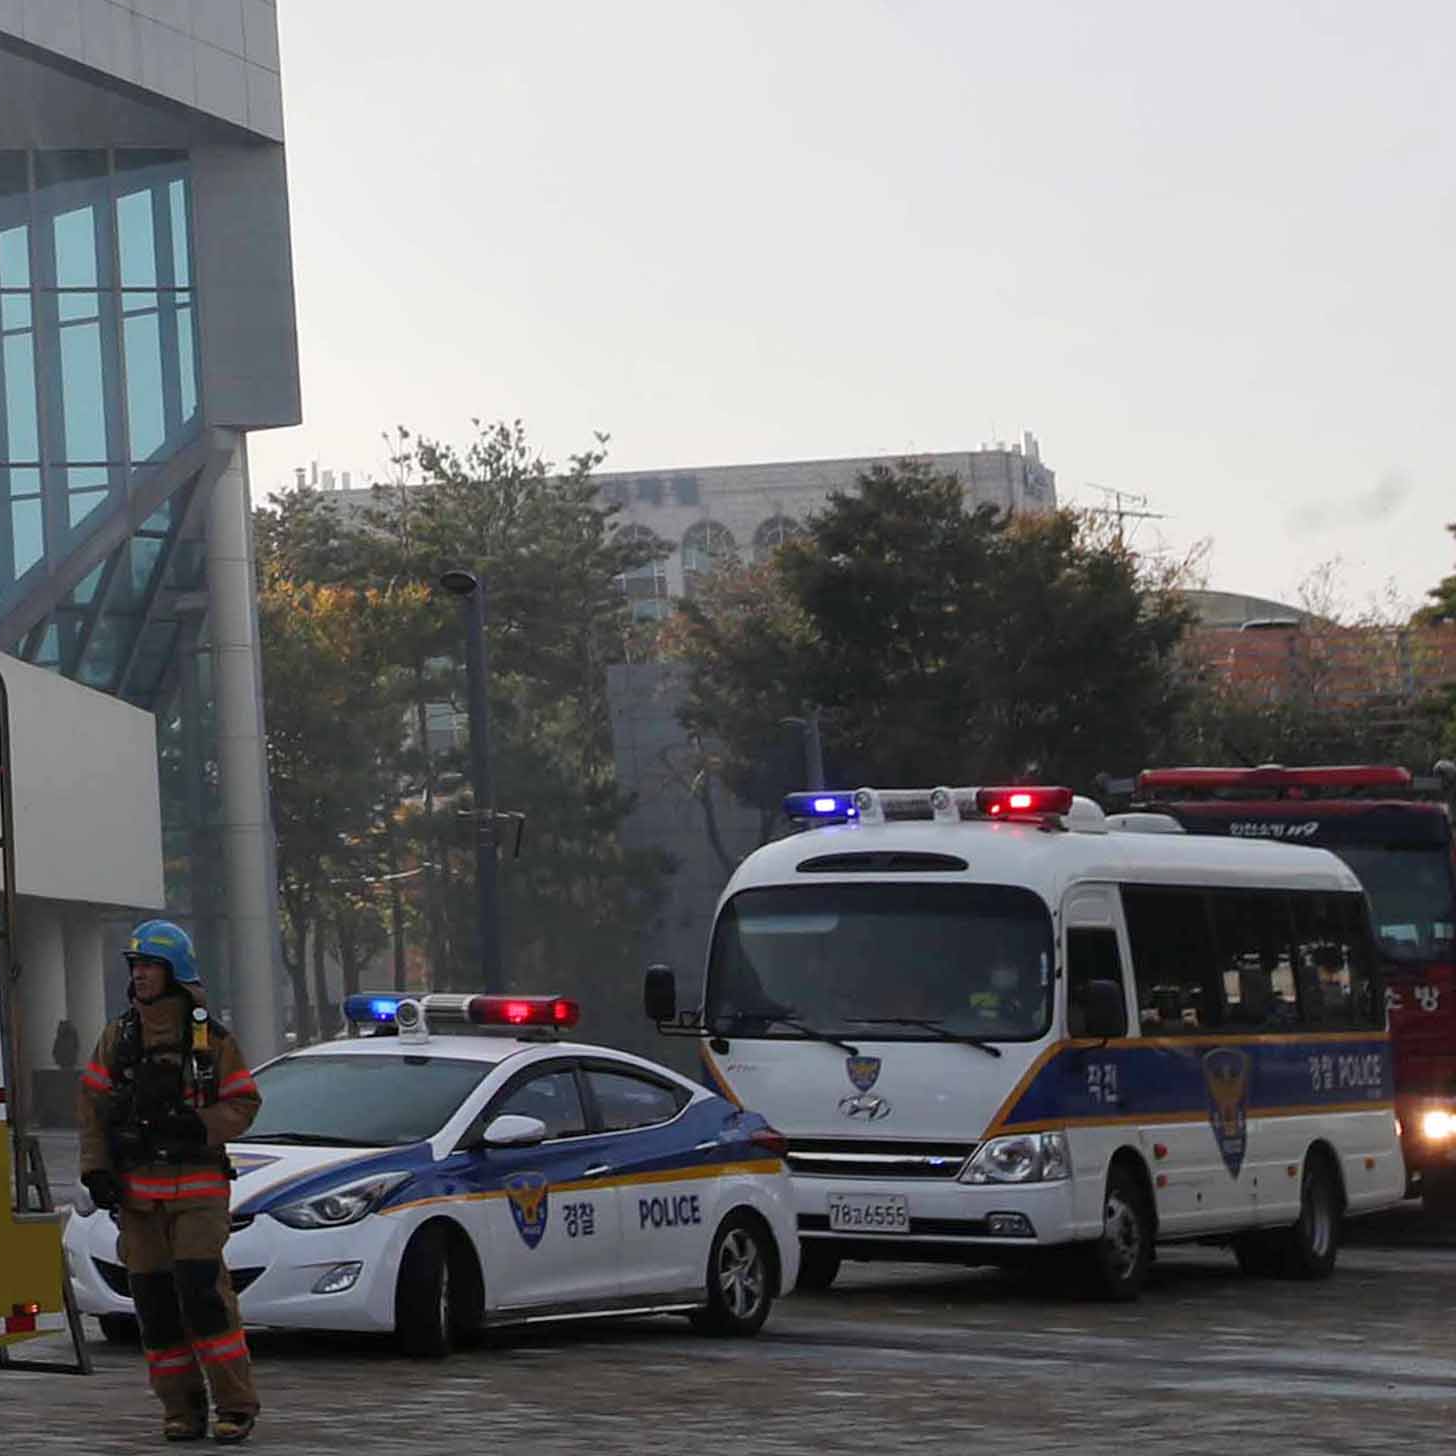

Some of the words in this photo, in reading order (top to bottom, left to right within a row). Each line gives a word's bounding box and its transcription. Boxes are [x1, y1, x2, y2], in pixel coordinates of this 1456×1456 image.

[1337, 1054, 1382, 1089] POLICE
[562, 1201, 596, 1238] 경찰
[638, 1194, 703, 1231] POLICE
